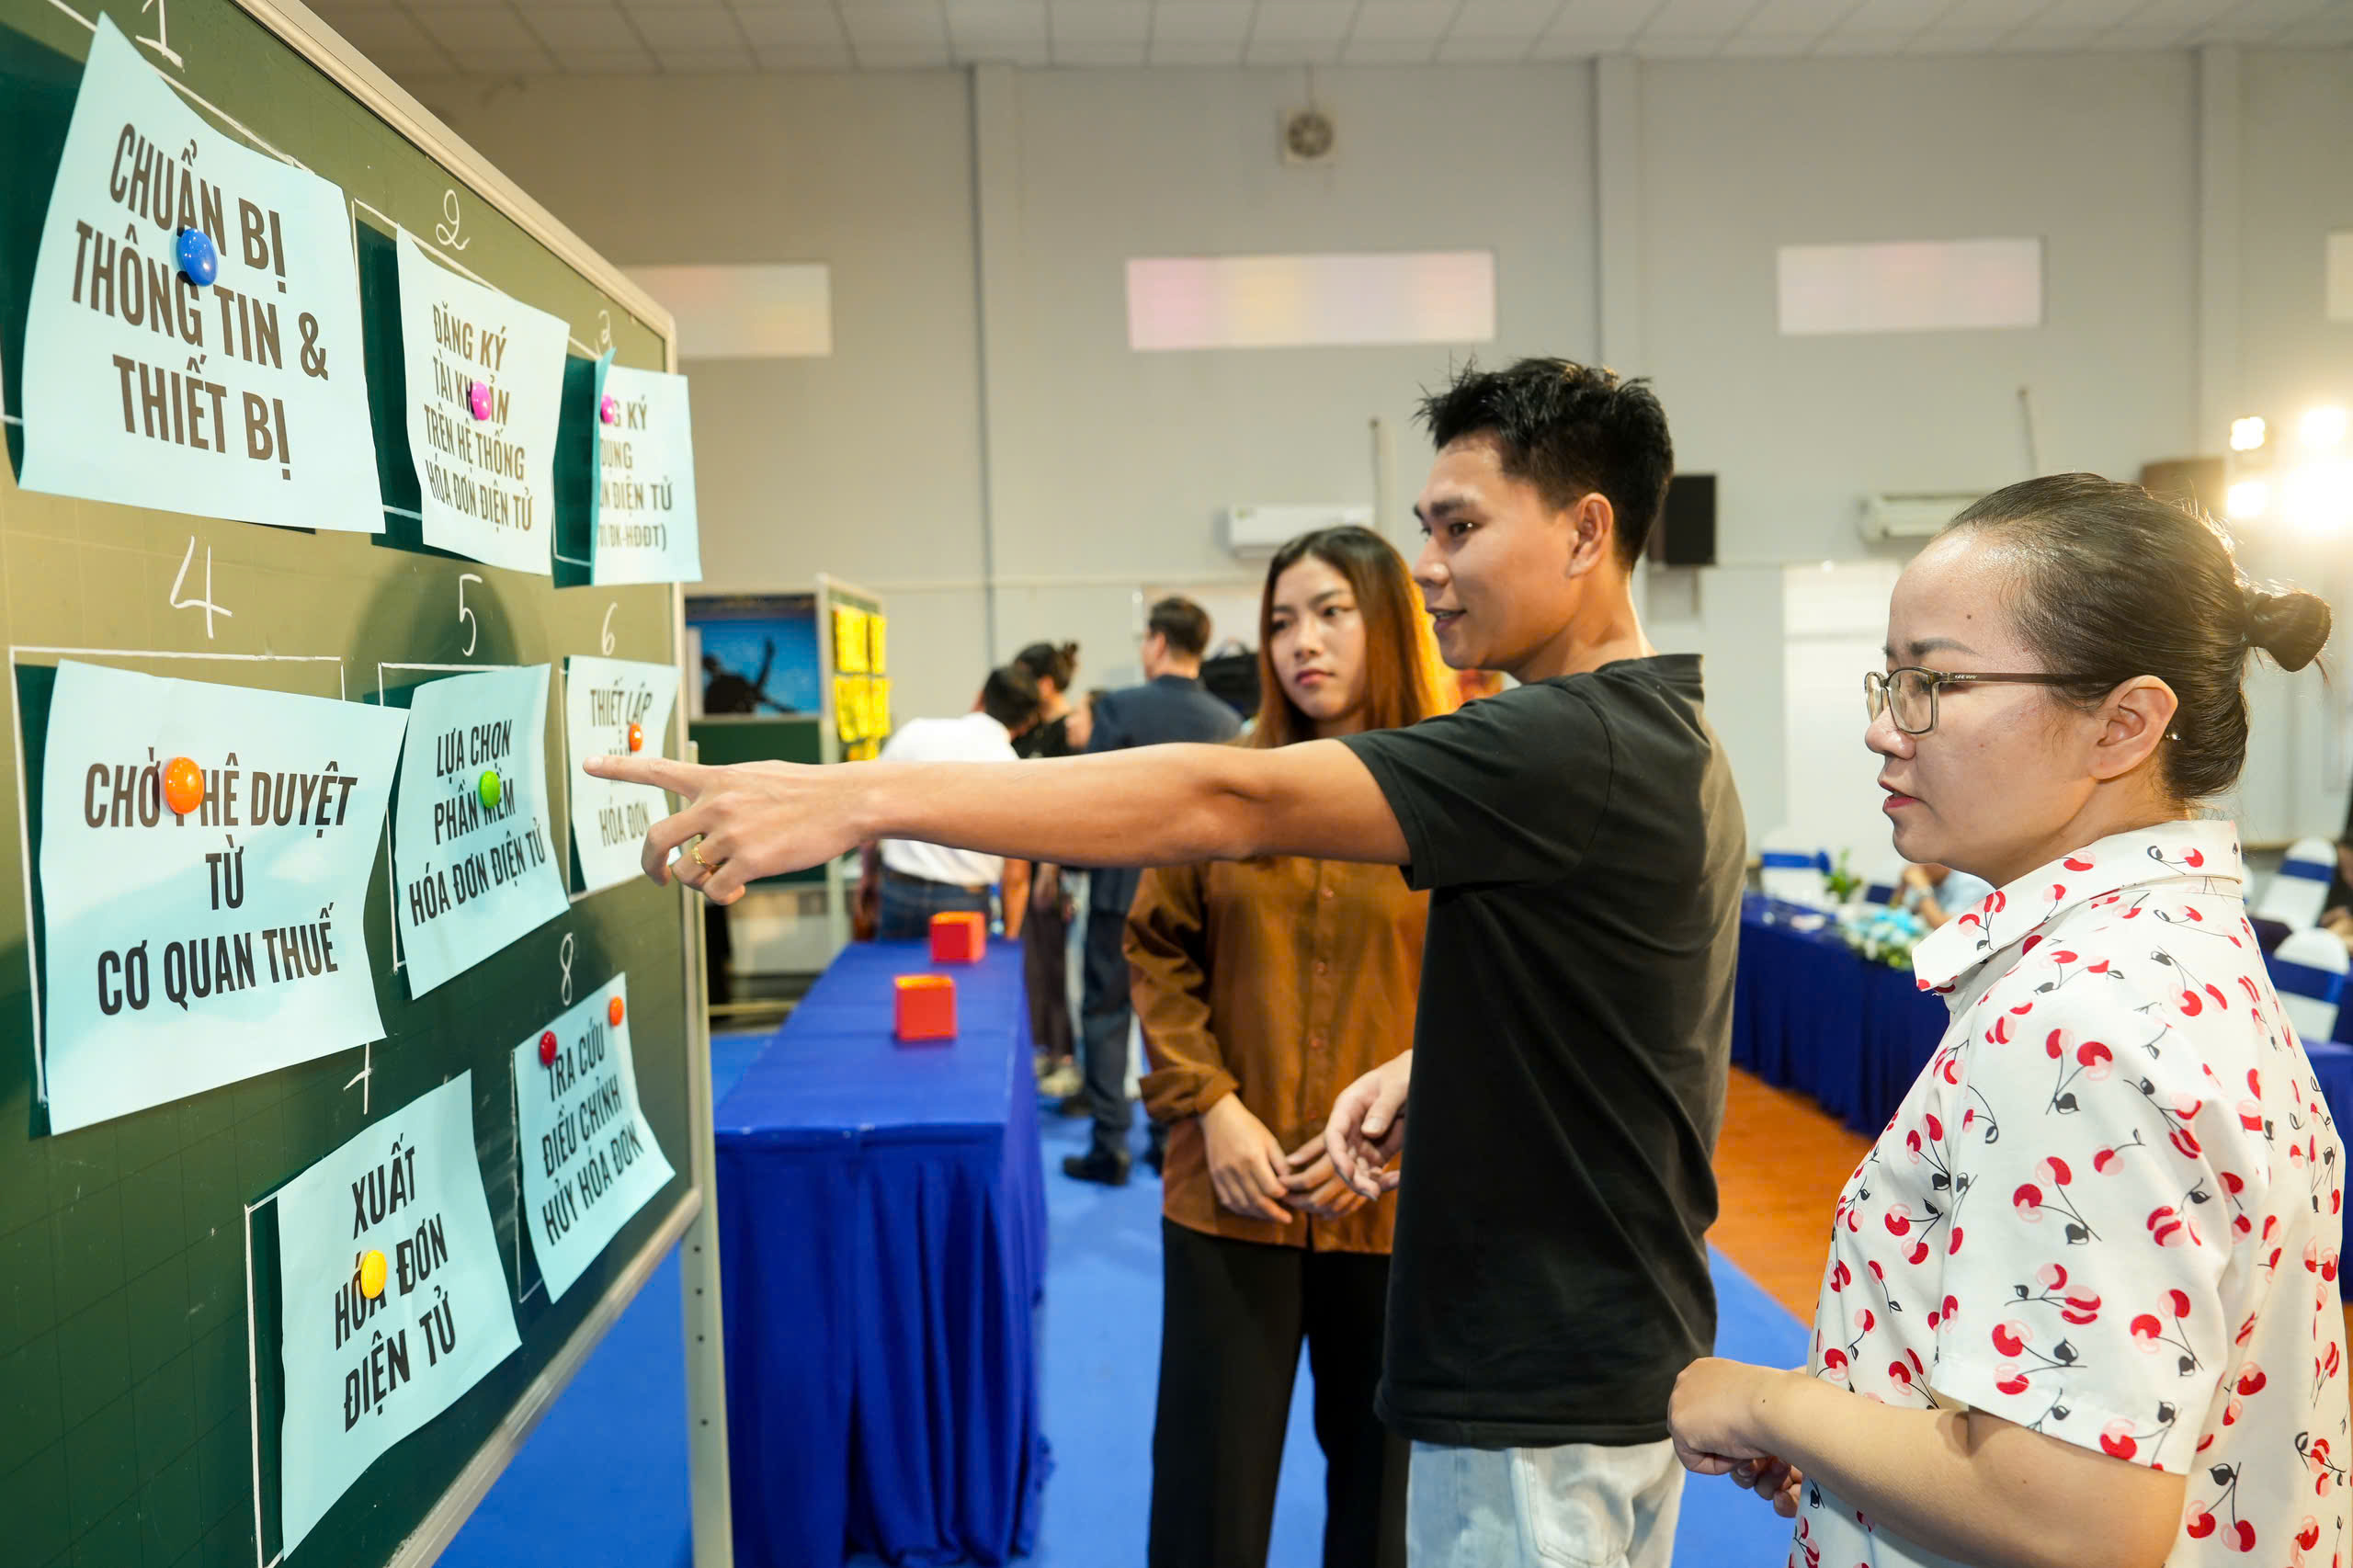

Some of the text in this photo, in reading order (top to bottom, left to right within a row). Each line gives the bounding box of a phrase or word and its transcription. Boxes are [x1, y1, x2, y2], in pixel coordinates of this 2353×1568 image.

[135, 0, 184, 70] 1
[110, 123, 287, 294] CHUẨN BỊ
[436, 189, 471, 250] 2
[73, 220, 329, 381] THÔNG TIN &
[433, 301, 507, 371] ĐĂNG KÝ
[113, 354, 291, 481] THIẾT BỊ
[433, 348, 510, 426] TÀI KHẢN
[425, 402, 525, 481] TRÊN HỆ THỐNG
[426, 452, 532, 533] HÓA ĐƠN ĐIỆN TỬ
[170, 536, 233, 640] 4
[460, 574, 483, 657] 5
[601, 602, 619, 656] 6
[590, 676, 624, 728] THIẾT
[85, 746, 358, 838] CHỜ HÊ DUYỆT
[437, 719, 512, 784] LỰA CHỌN
[434, 778, 479, 846] PHẦN
[205, 835, 244, 911] TỪ
[409, 817, 546, 926] HÓA ĐƠN ĐIỆN TỬ
[97, 903, 338, 1017] CƠ QUAN THUẾ
[559, 932, 574, 1006] 8
[547, 1016, 605, 1103] TRA CỨU
[541, 1074, 622, 1178] ĐIỀU CHỈNH
[351, 1132, 415, 1240] XUẤT
[542, 1177, 578, 1246] HỦY
[577, 1143, 613, 1210] HÓA
[396, 1213, 449, 1297] ĐƠN
[344, 1285, 456, 1434] ĐIỆN TỬ
